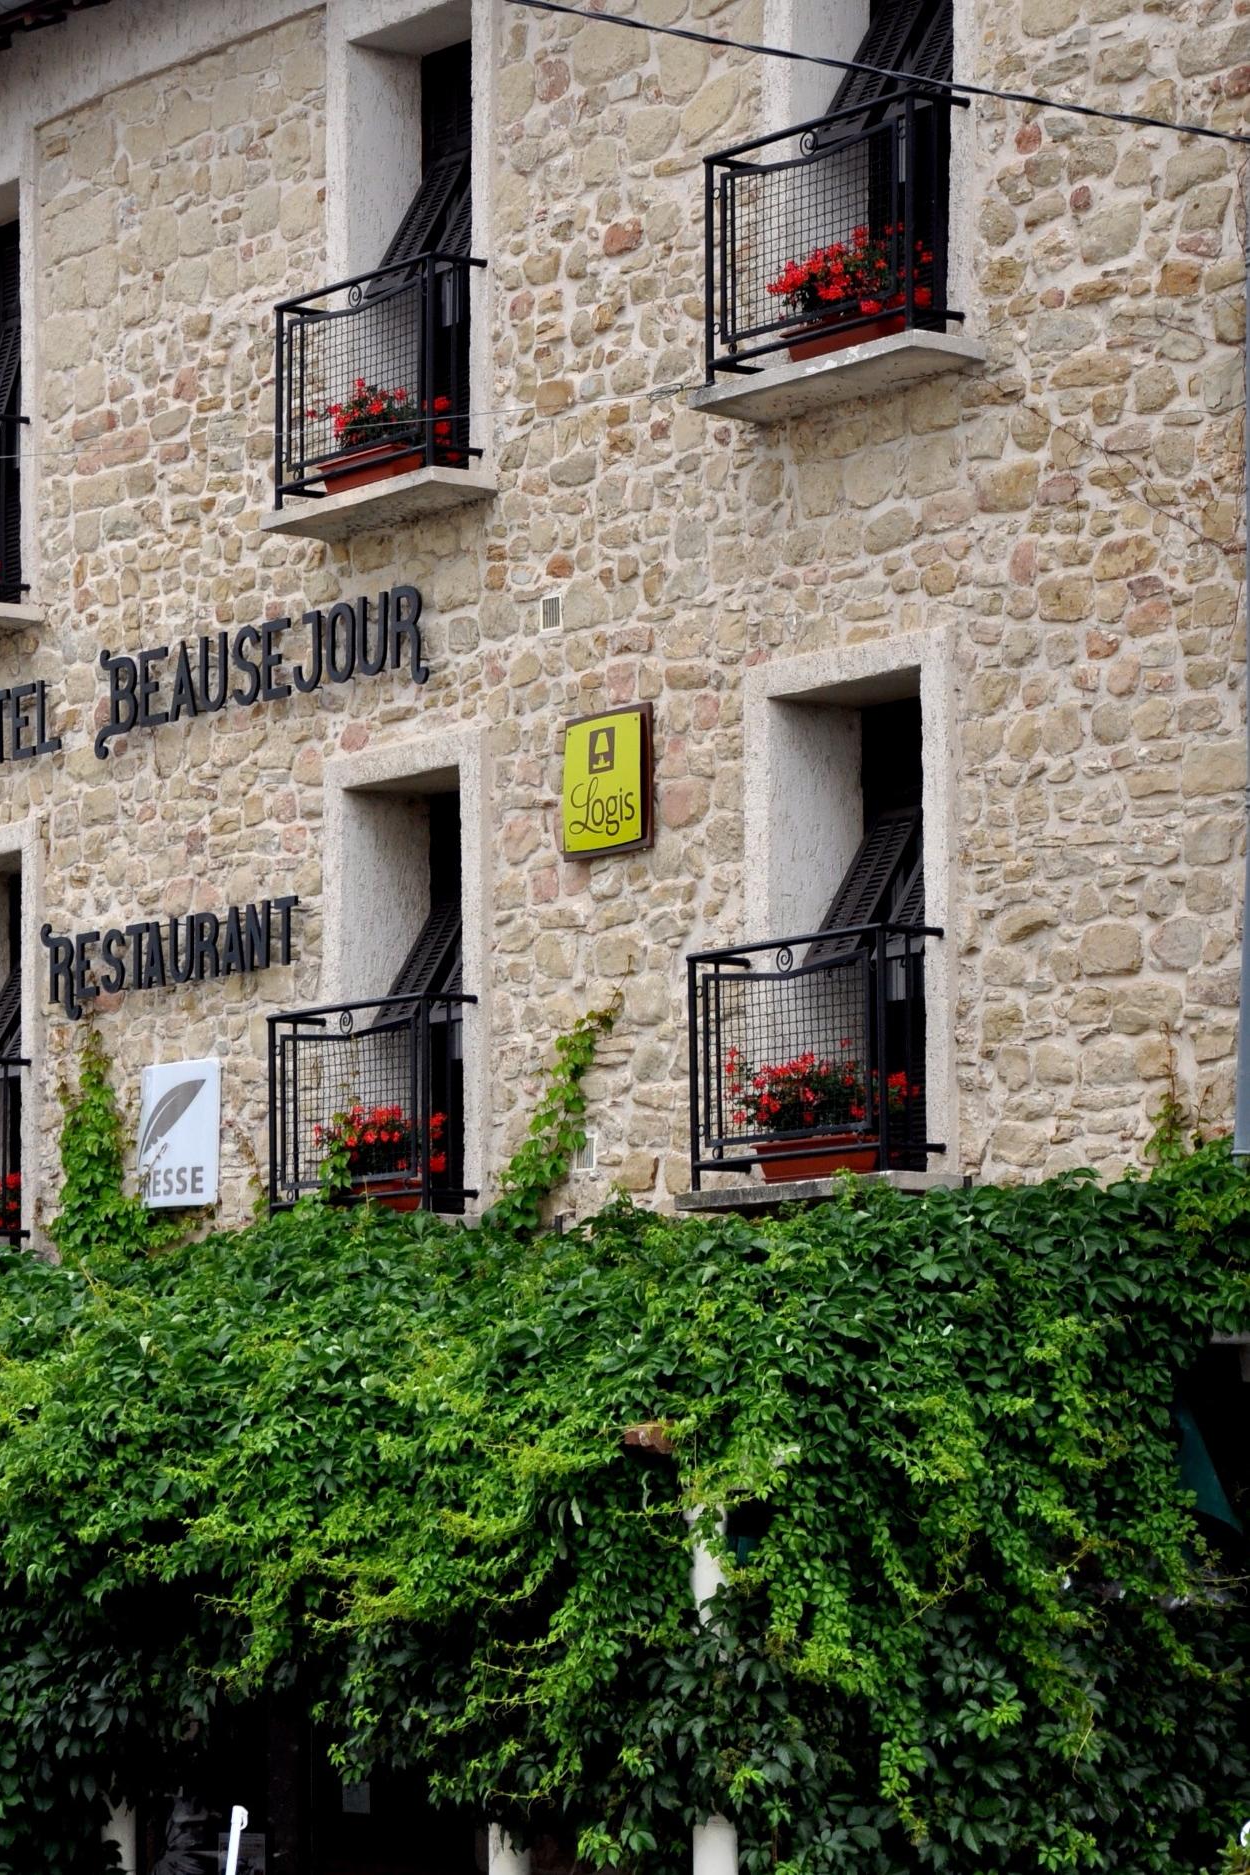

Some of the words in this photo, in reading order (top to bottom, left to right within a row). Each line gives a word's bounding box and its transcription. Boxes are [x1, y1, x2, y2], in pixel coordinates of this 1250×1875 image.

[94, 585, 429, 760] BEAUSEJOUR
[568, 776, 635, 836] Logis
[41, 895, 299, 1021] RESTAURANT
